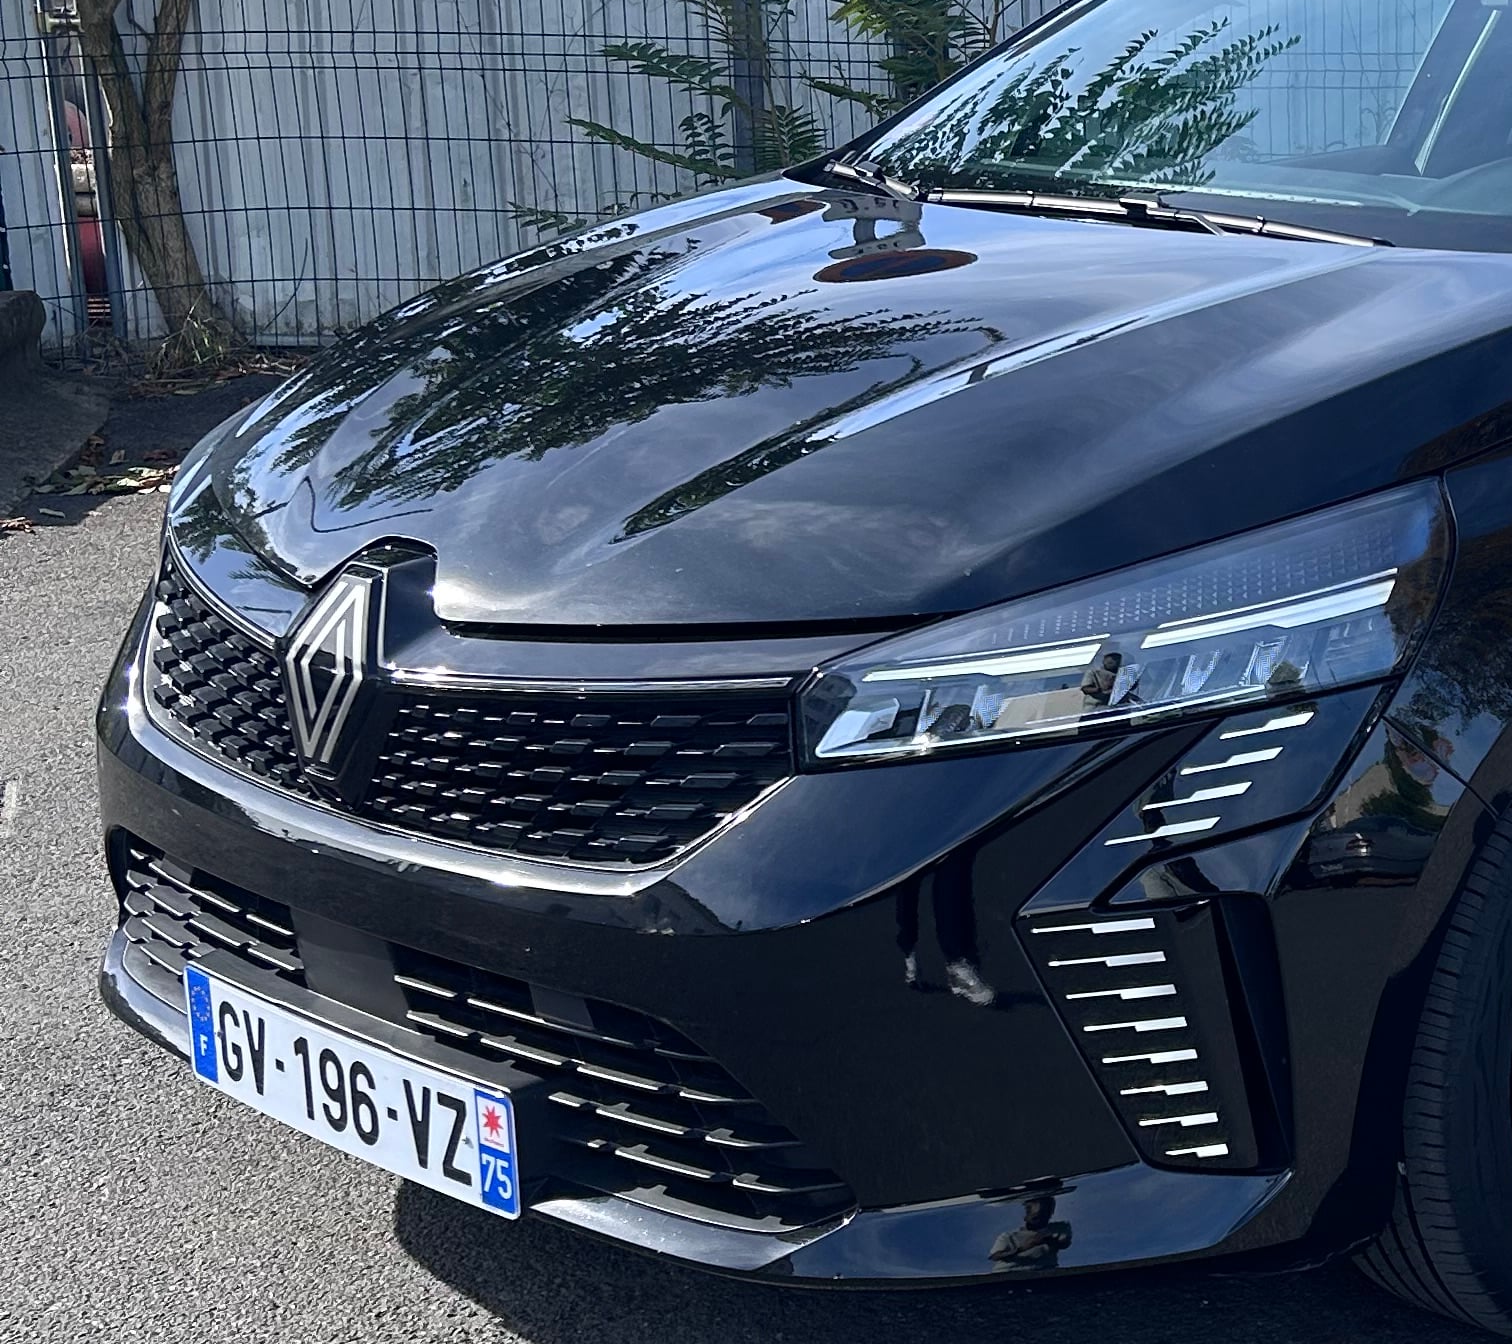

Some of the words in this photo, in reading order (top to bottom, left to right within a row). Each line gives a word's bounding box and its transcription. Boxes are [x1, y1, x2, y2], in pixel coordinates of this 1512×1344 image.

[199, 1034, 210, 1057] F
[218, 1000, 473, 1187] GV-196-VZ
[481, 1152, 513, 1200] 75
